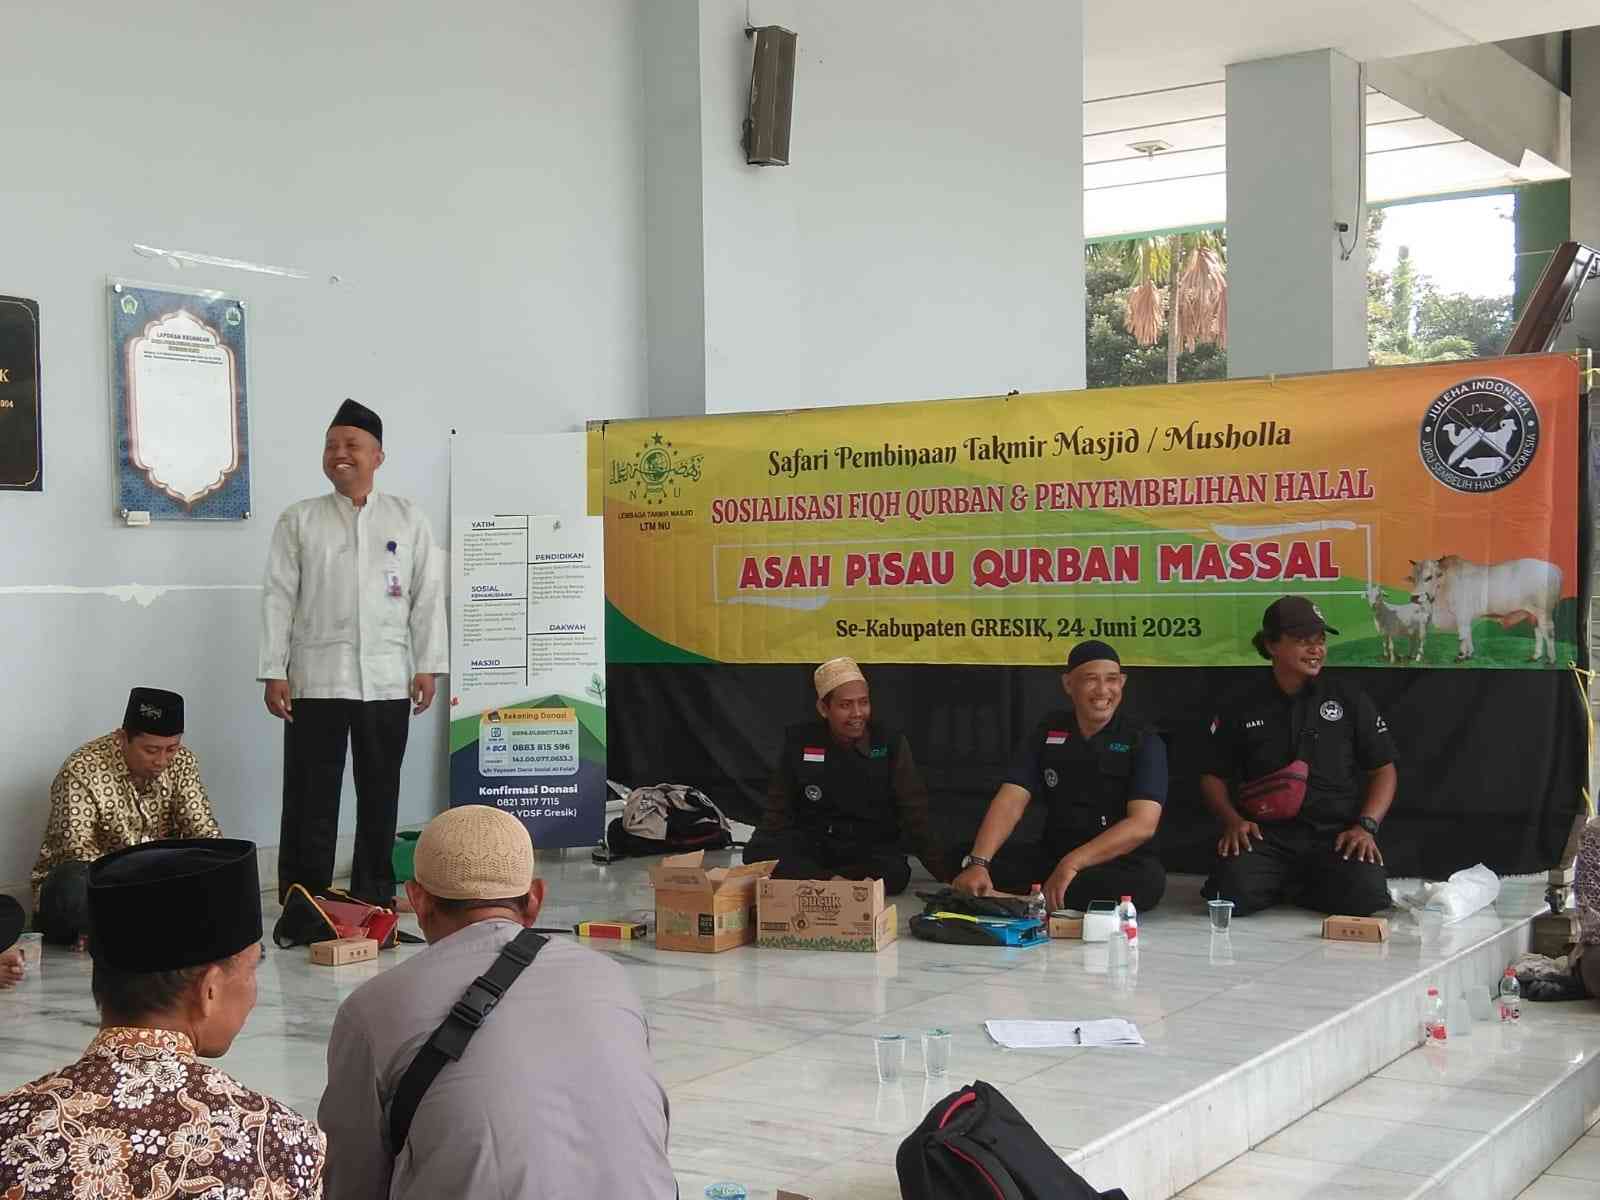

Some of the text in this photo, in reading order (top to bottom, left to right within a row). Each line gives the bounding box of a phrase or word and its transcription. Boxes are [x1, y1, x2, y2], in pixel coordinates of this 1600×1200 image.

[1429, 381, 1531, 421] JULEHA INDONESIA
[768, 421, 1291, 478] Safari Pembinaan Takmir Masjid / Musholla
[1432, 462, 1473, 489] SEMBELIH
[1474, 475, 1505, 490] HALAL
[1504, 433, 1536, 480] INDONESIA
[711, 469, 1374, 524] SOSIALISASI FIQH QURBAN & PENYEMBELIHAN HALAL
[640, 521, 671, 531] LTM NU
[739, 541, 1340, 589] ASAH PISAU QURBAN MASSAL
[836, 616, 1202, 641] Se-Kabupaten GRESIK, 24 Juni 2023
[479, 784, 577, 796] Konfirmasi Donasi
[496, 798, 560, 806] 0821 3117 7115
[516, 808, 577, 817] YDSF Gresik)
